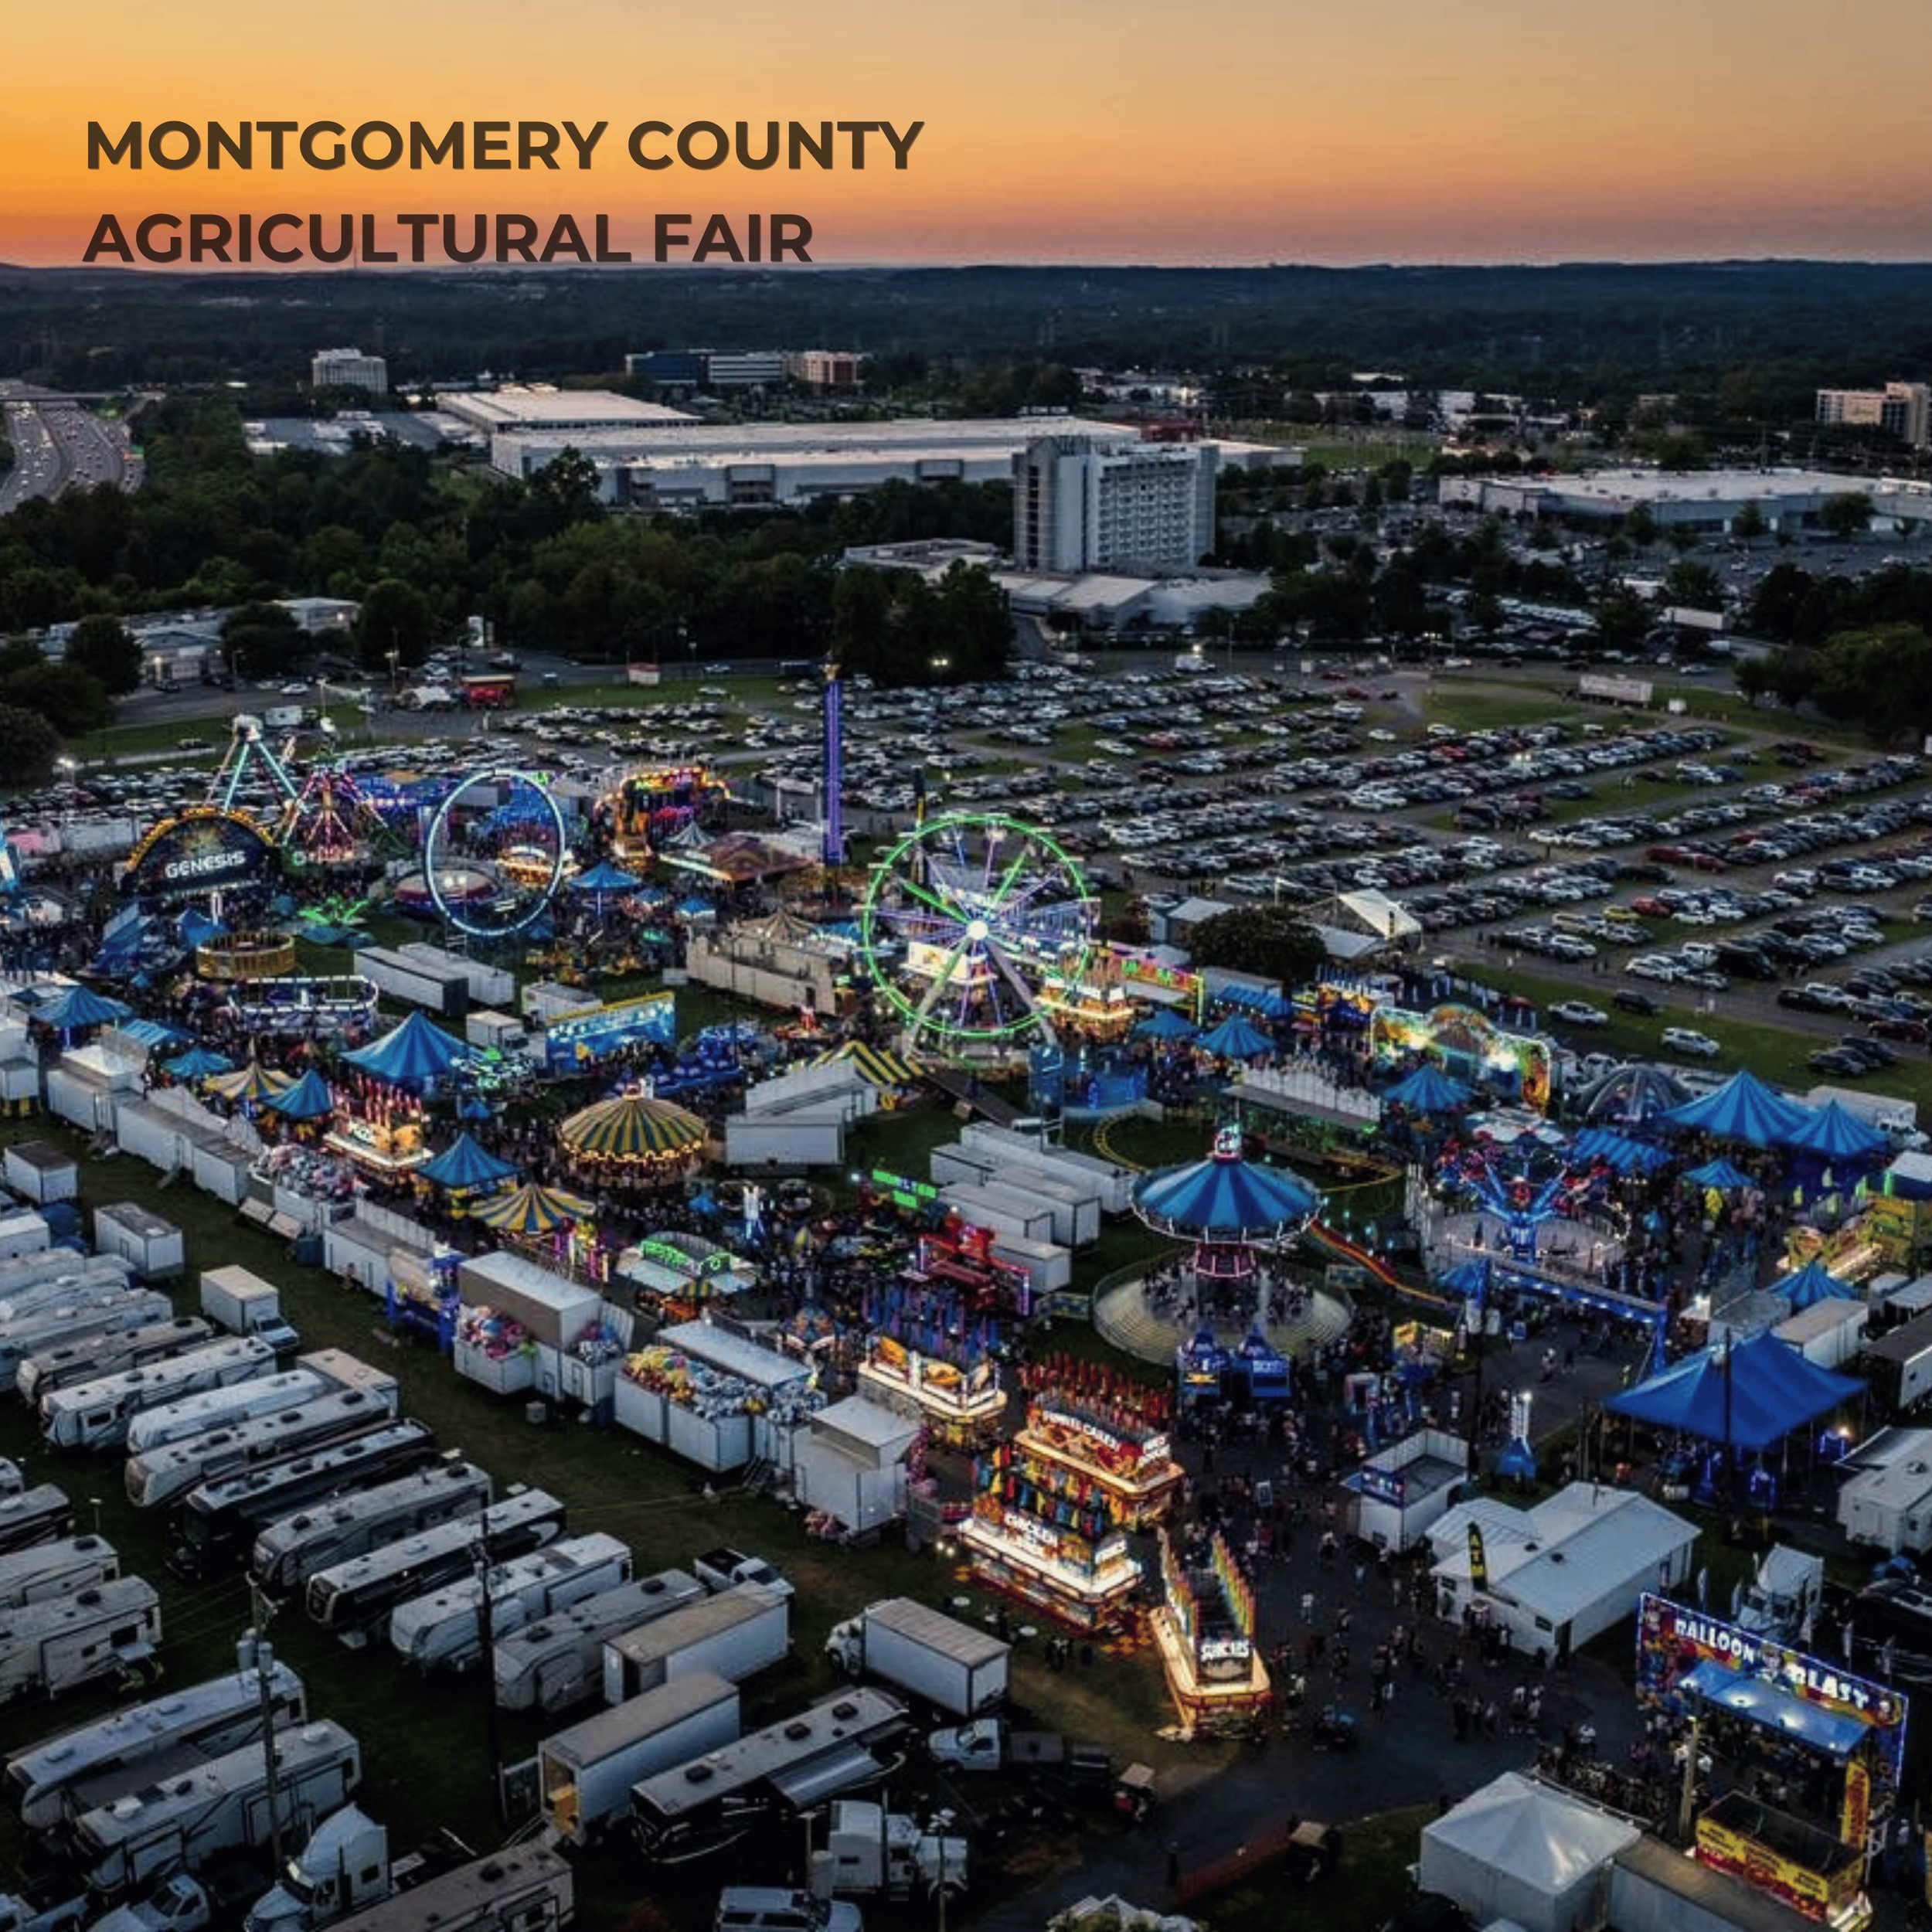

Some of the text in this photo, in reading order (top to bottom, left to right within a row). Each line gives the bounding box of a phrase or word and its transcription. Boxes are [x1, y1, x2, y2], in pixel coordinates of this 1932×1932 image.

[165, 850, 246, 879] GENESIS
[1470, 1533, 1484, 1576] ATM
[1674, 1617, 1755, 1665] BALLOON
